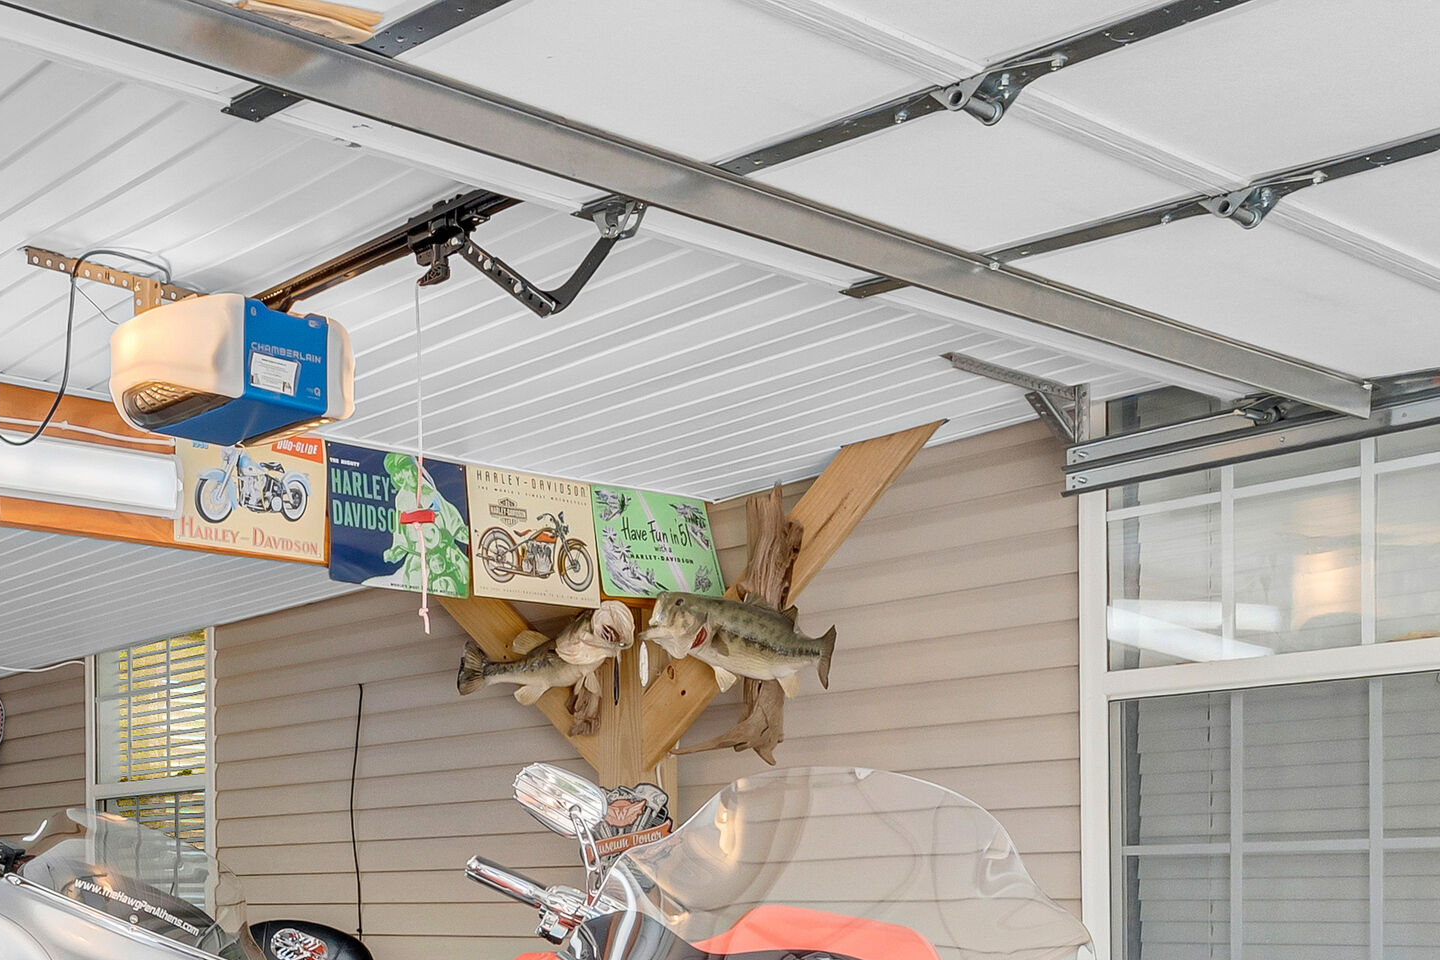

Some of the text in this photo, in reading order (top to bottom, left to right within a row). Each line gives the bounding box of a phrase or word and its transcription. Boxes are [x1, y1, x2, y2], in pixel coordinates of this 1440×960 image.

[250, 341, 322, 364] CHAMBERLAIN
[276, 439, 319, 455] DUO-GLIDE
[331, 467, 397, 502] HARLEY-
[476, 469, 587, 498] HARLEY-DAVIDSON
[621, 516, 647, 541] Have
[648, 520, 668, 543] Fun
[669, 528, 679, 545] in
[598, 838, 629, 855] useum
